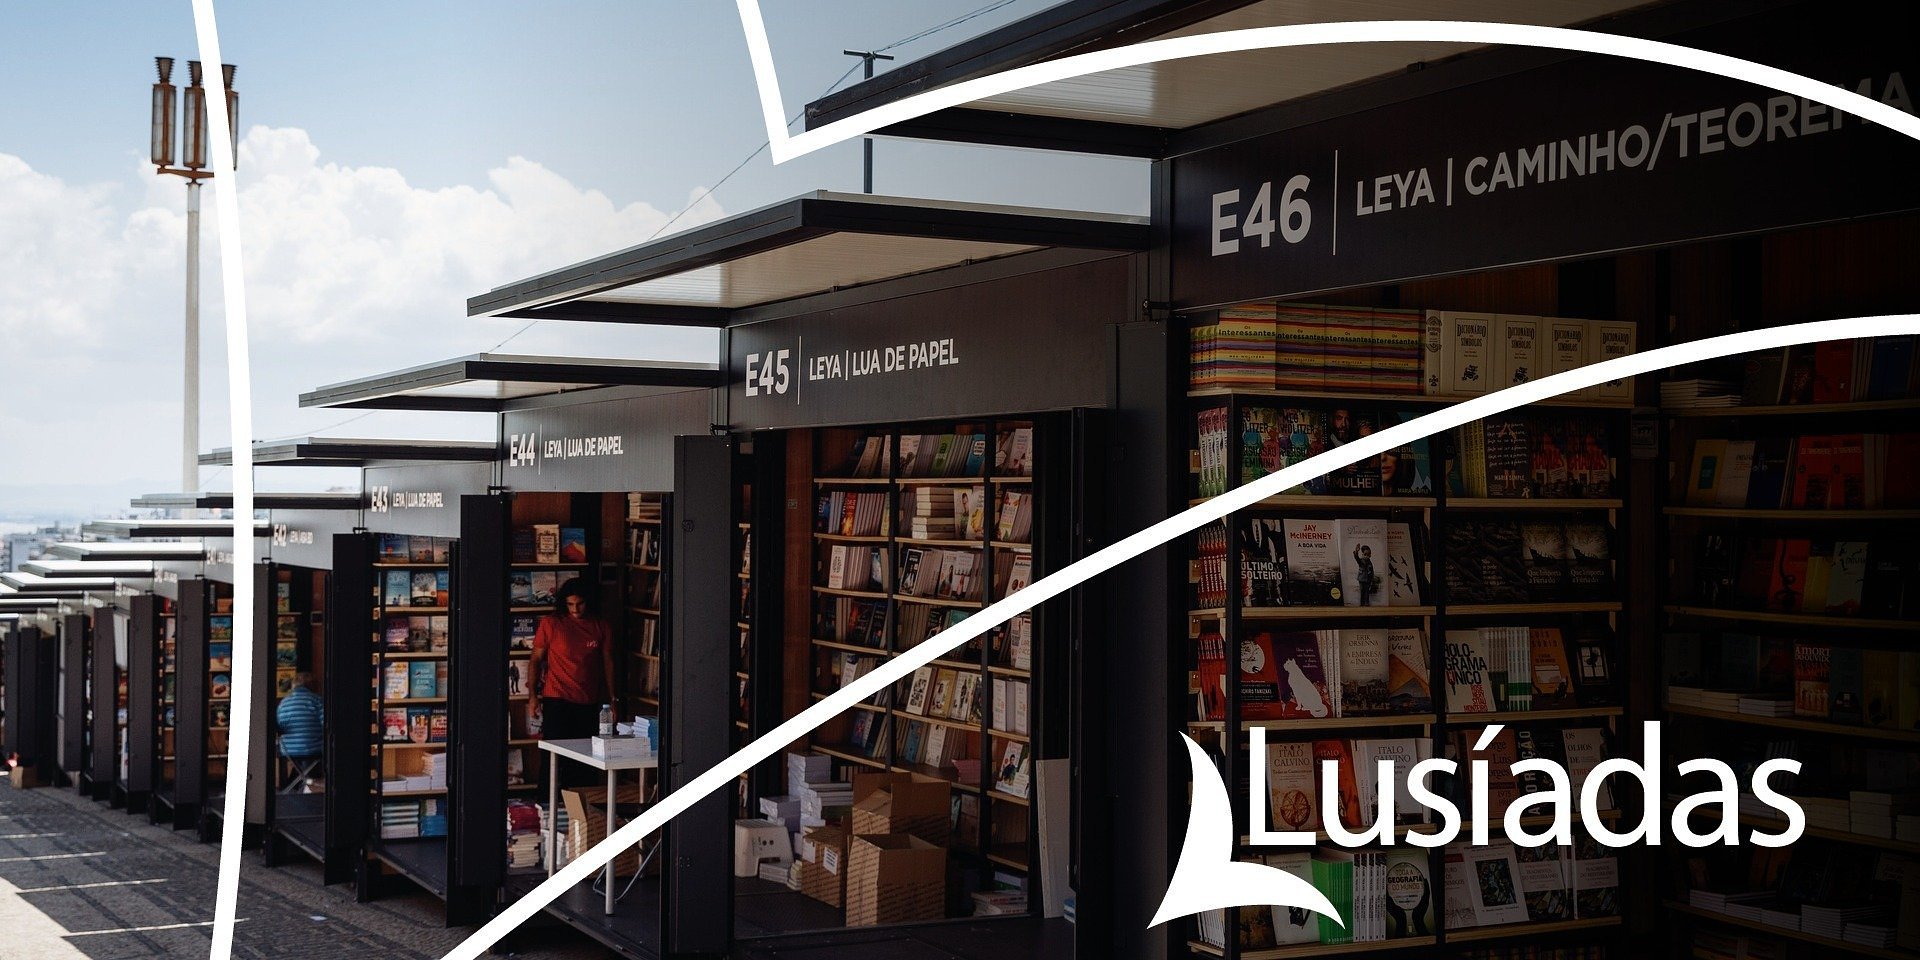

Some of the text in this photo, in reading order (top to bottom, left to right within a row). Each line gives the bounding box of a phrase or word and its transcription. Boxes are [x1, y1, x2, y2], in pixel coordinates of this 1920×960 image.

[1355, 167, 1435, 217] LEYA
[1211, 173, 1312, 257] E46
[809, 338, 959, 381] LEYA LUA DE PAPEL
[745, 349, 790, 397] E45
[509, 432, 535, 467] E44
[544, 435, 624, 458] LEYA LUA DE PAPEL
[371, 485, 389, 513] E43
[392, 492, 444, 508] LEYA LUA DE PAPEL
[1303, 524, 1317, 532] JAY
[1290, 532, 1333, 540] McINERNEY
[1241, 571, 1283, 580] SOLTEIRO
[1444, 656, 1488, 671] GRAMA
[1378, 746, 1404, 754] ITALO
[1488, 740, 1506, 752] orge
[1568, 743, 1592, 752] OLHOS
[1279, 749, 1304, 757] ITALO
[1274, 758, 1310, 766] CALVINO
[1488, 769, 1510, 779] orges
[1518, 731, 1541, 815] AORÇÃO
[1387, 875, 1423, 884] GEOGRAFIA
